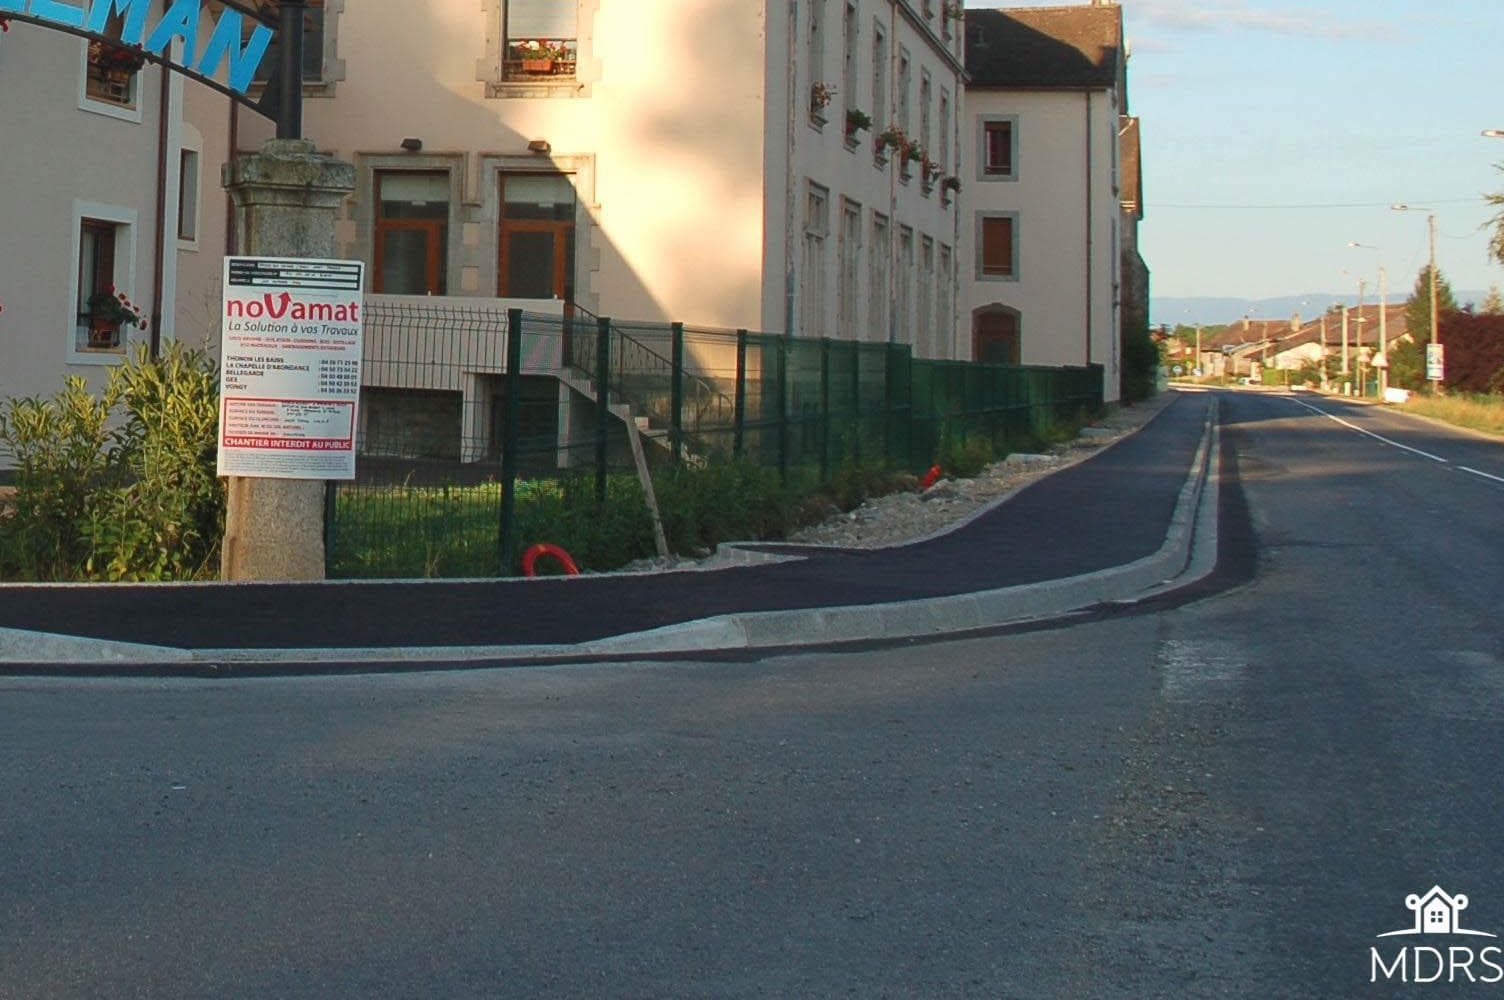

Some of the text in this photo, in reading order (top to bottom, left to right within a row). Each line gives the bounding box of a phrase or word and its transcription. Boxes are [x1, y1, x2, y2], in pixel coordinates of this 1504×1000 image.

[228, 321, 240, 331] La
[244, 321, 288, 333] Solution
[301, 326, 318, 335] vos
[322, 324, 359, 336] Travaux
[224, 438, 350, 449] CHANTIER INTERDIT AU PUBLIC
